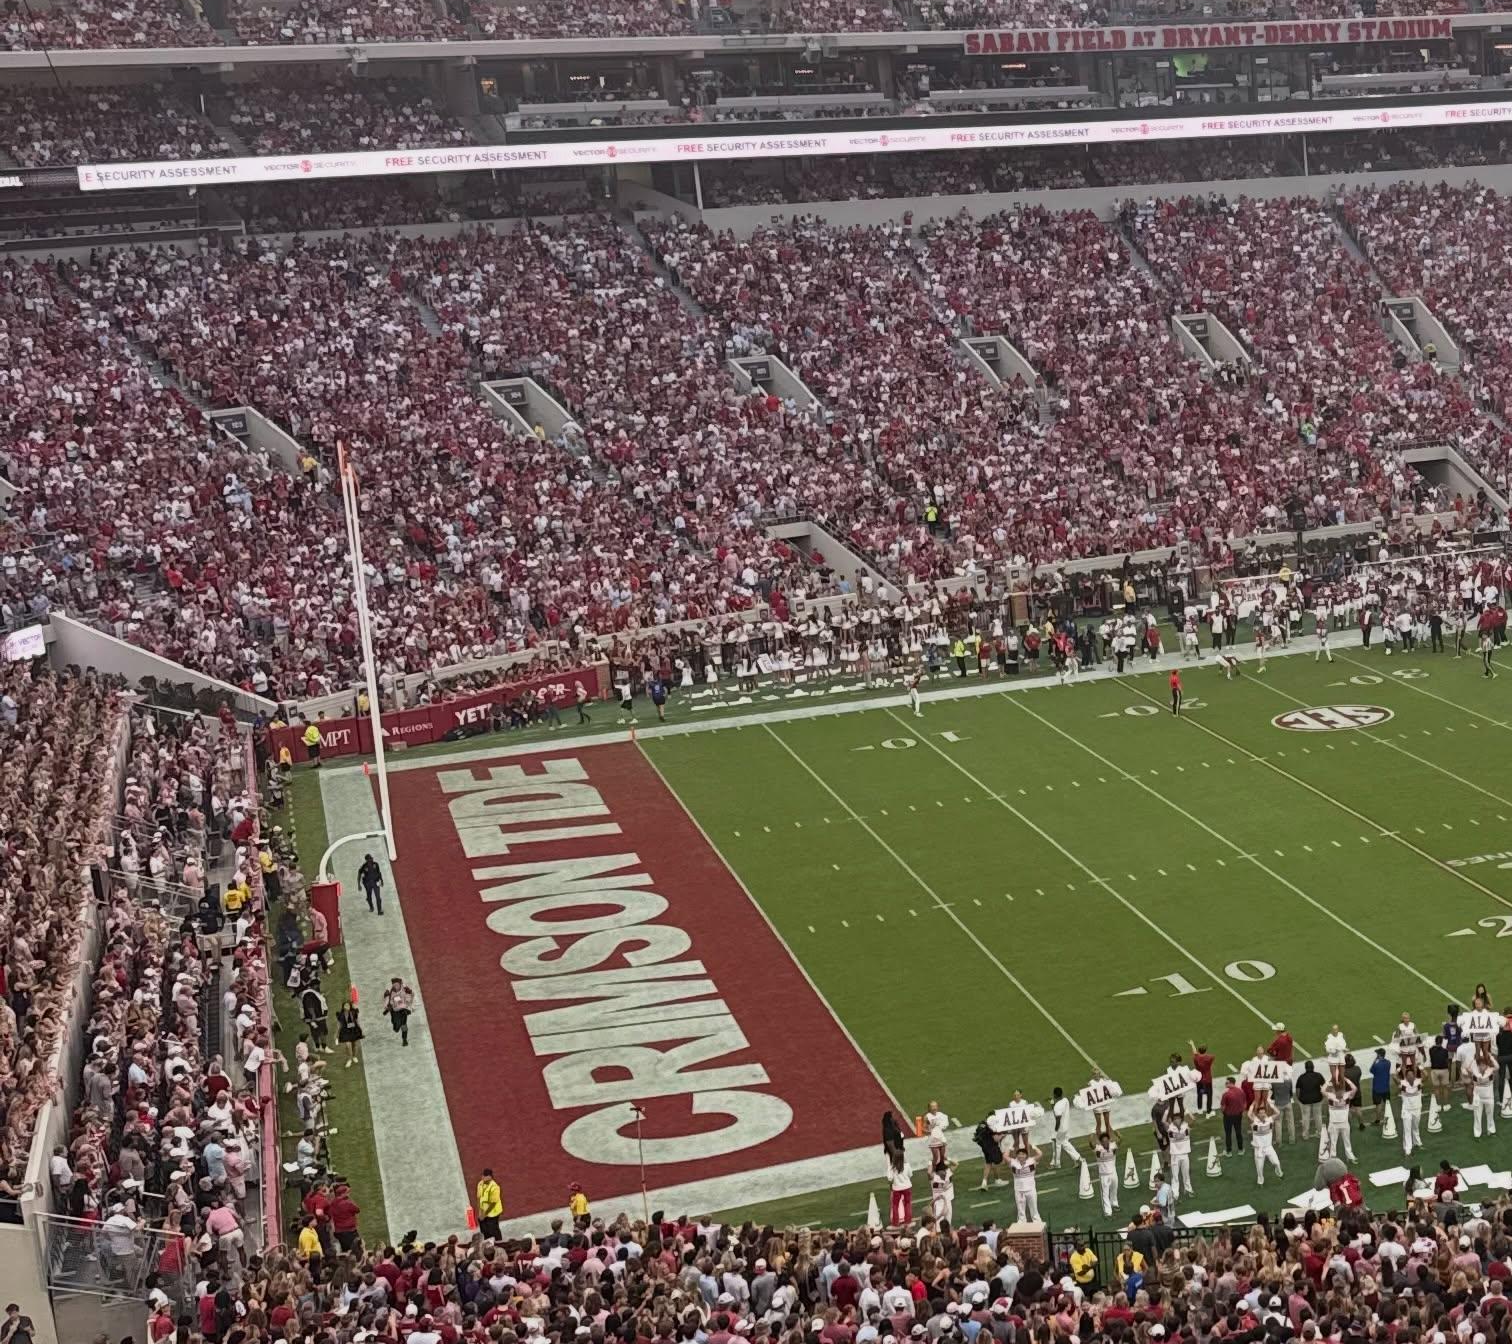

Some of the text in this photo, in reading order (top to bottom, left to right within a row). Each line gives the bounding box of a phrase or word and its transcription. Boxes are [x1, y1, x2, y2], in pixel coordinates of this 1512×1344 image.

[965, 18, 1453, 54] SABAN FIELD AT BRYANT-DENNY STADIUM
[1445, 109, 1469, 119] FREE
[1470, 107, 1512, 117] SECURITY
[1202, 116, 1333, 130] FREE SECURITY ASSESSMENT
[951, 128, 1090, 143] FREE SECURITY ASSESSMENT
[677, 138, 828, 153] FREE SECURITY ASSESSMENT
[385, 150, 549, 167] FREE SECURITY ASSESSMENT
[96, 170, 155, 182] SECURITY
[159, 165, 237, 178] ASSESSMENT
[1279, 706, 1384, 732] SEC
[392, 722, 434, 736] REGIONS
[436, 757, 624, 859] TIDE
[1153, 959, 1279, 999] 10
[472, 852, 794, 1165] CRIMSON
[1469, 1016, 1493, 1029] ALA
[1254, 1064, 1279, 1079] ALA
[1163, 1072, 1189, 1096] ALA
[1086, 1085, 1112, 1107] ALA
[1003, 1109, 1029, 1127] ALA
[1339, 1180, 1353, 1205] 1
